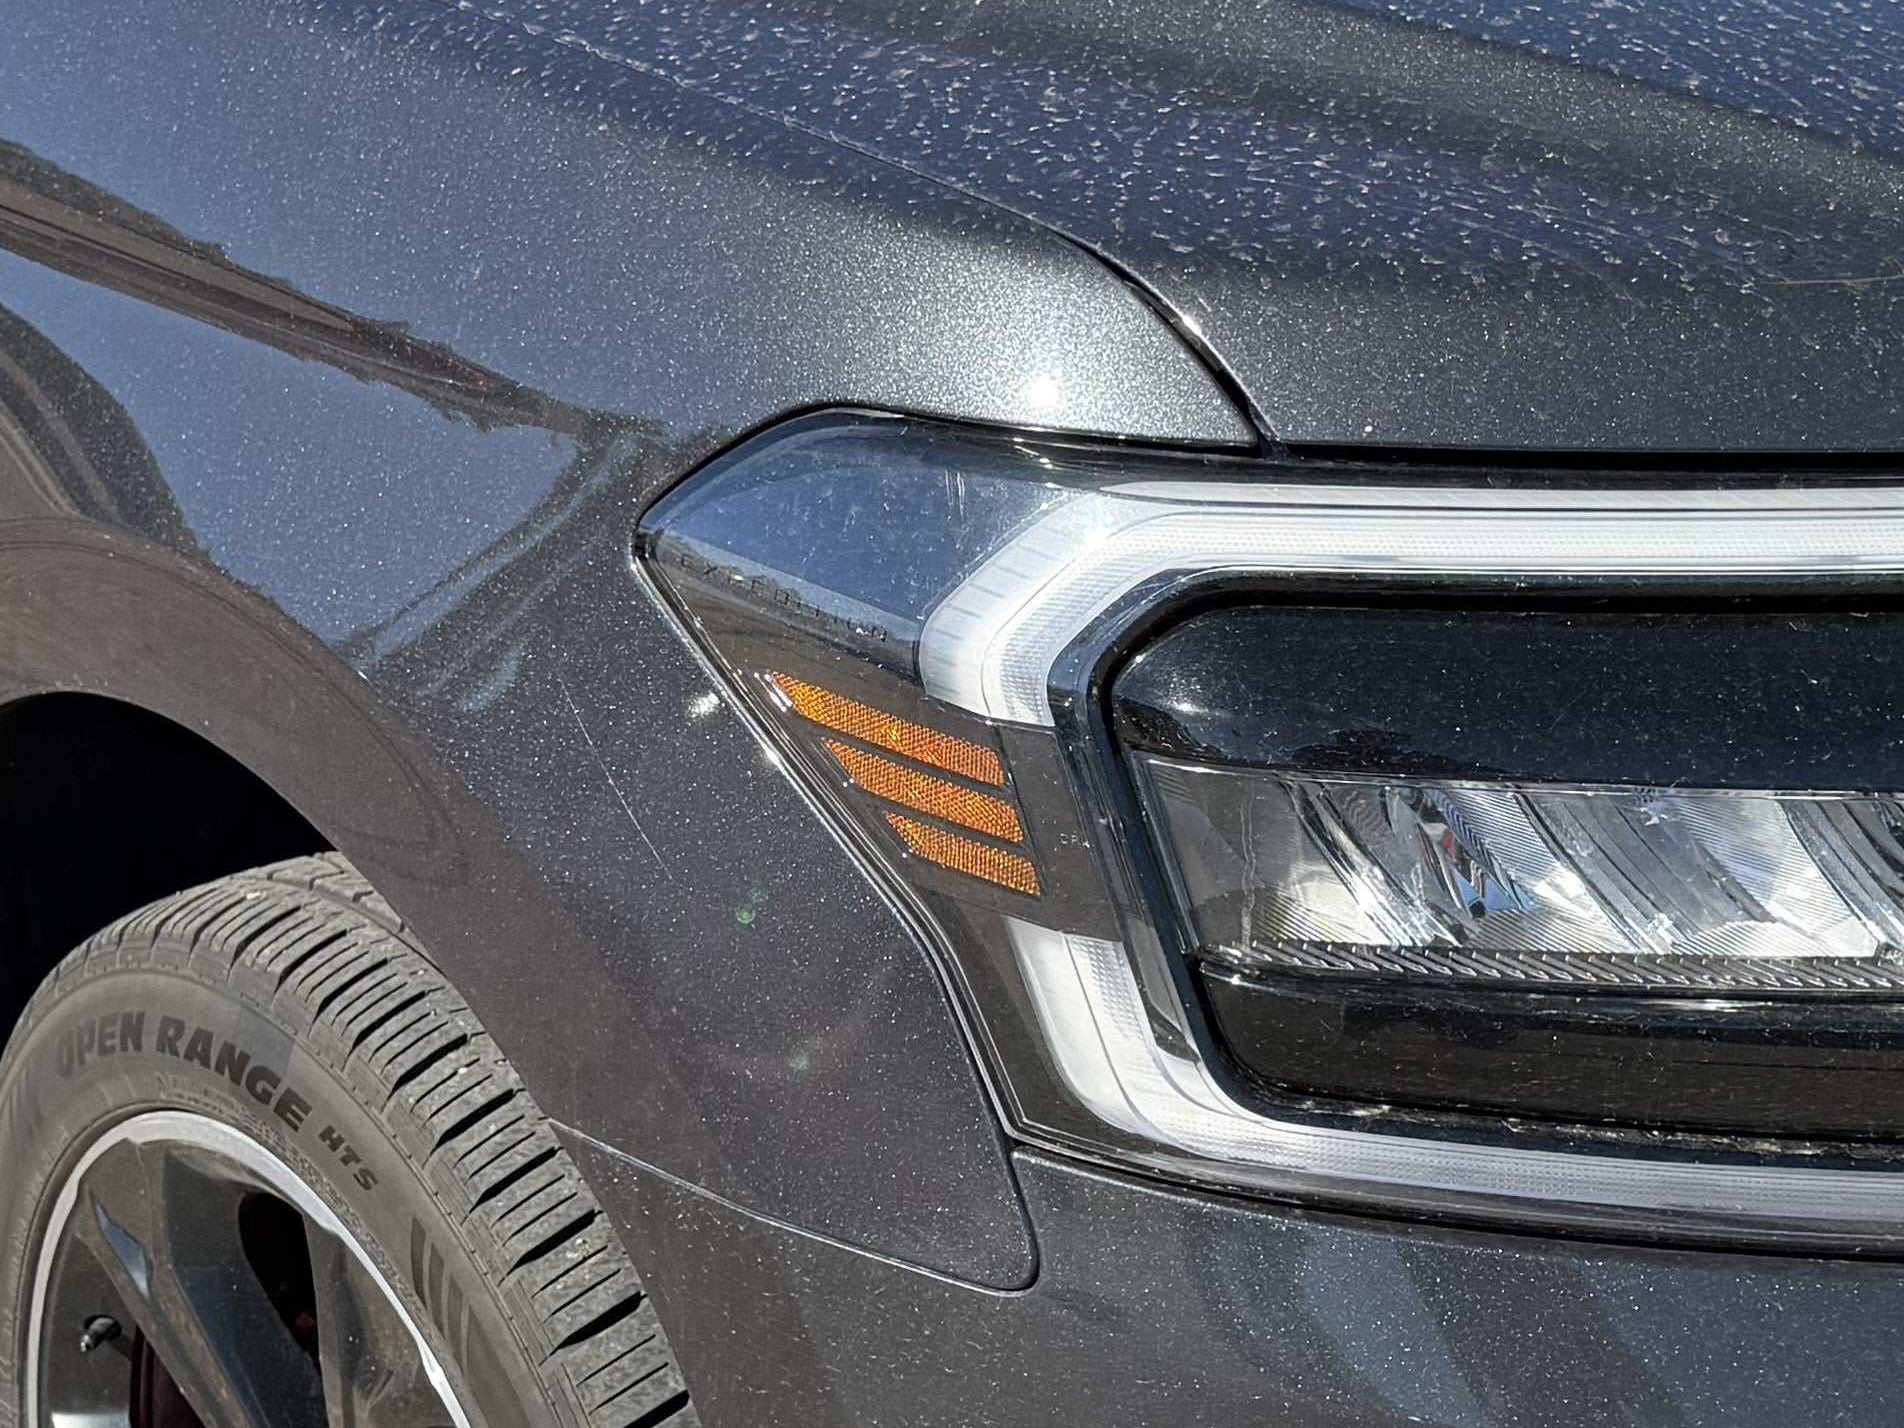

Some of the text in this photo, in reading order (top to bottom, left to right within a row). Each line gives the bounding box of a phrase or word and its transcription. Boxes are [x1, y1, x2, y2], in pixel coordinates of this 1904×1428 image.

[56, 1011, 146, 1080] OPEN
[156, 1014, 313, 1133] RANGE
[318, 1124, 379, 1192] HTS
